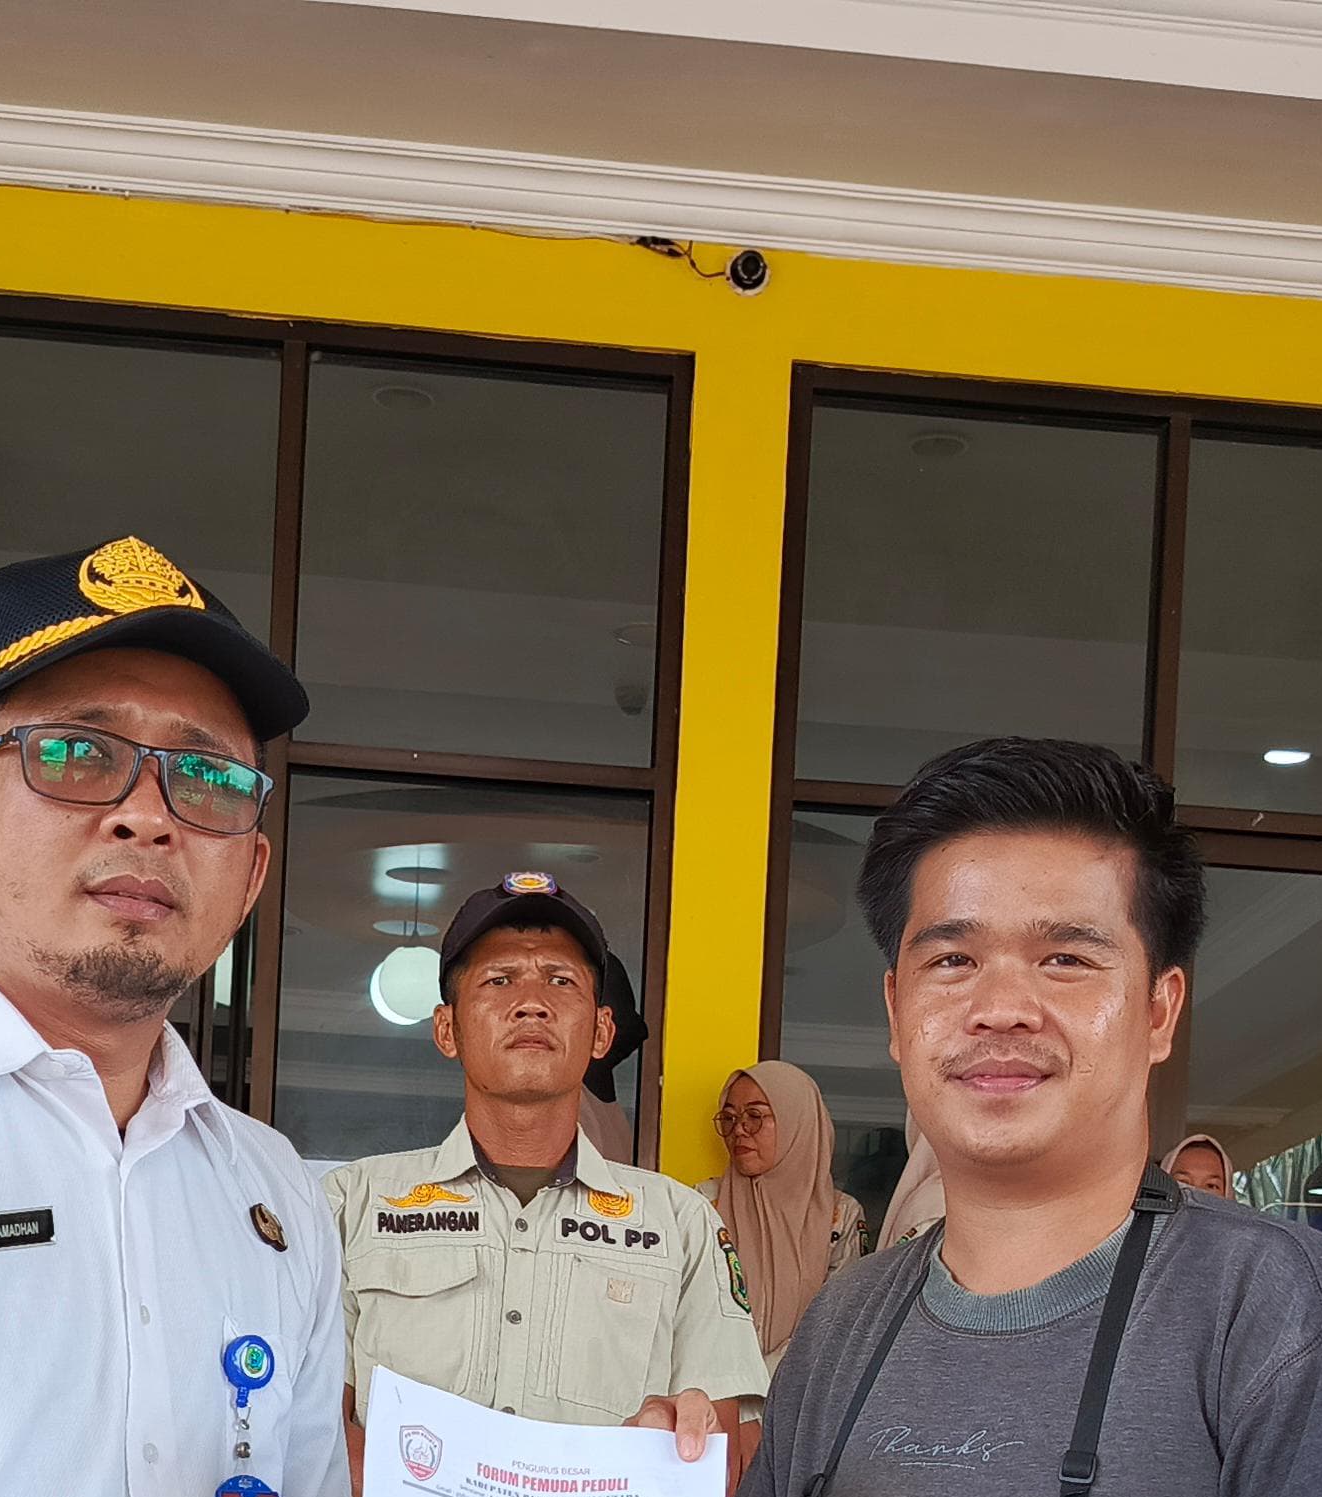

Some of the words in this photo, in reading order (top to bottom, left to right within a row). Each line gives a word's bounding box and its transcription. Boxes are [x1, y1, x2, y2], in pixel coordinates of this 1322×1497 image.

[377, 1211, 479, 1233] PANERANGAN
[561, 1217, 616, 1244] POL
[624, 1228, 661, 1249] PP
[867, 1426, 1025, 1462] Thanks
[476, 1462, 520, 1488] FORUM
[522, 1474, 578, 1492] PEMUDA
[581, 1478, 629, 1493] PEDULI
[511, 1459, 559, 1475] PENGURUS
[561, 1467, 591, 1476] BESAR
